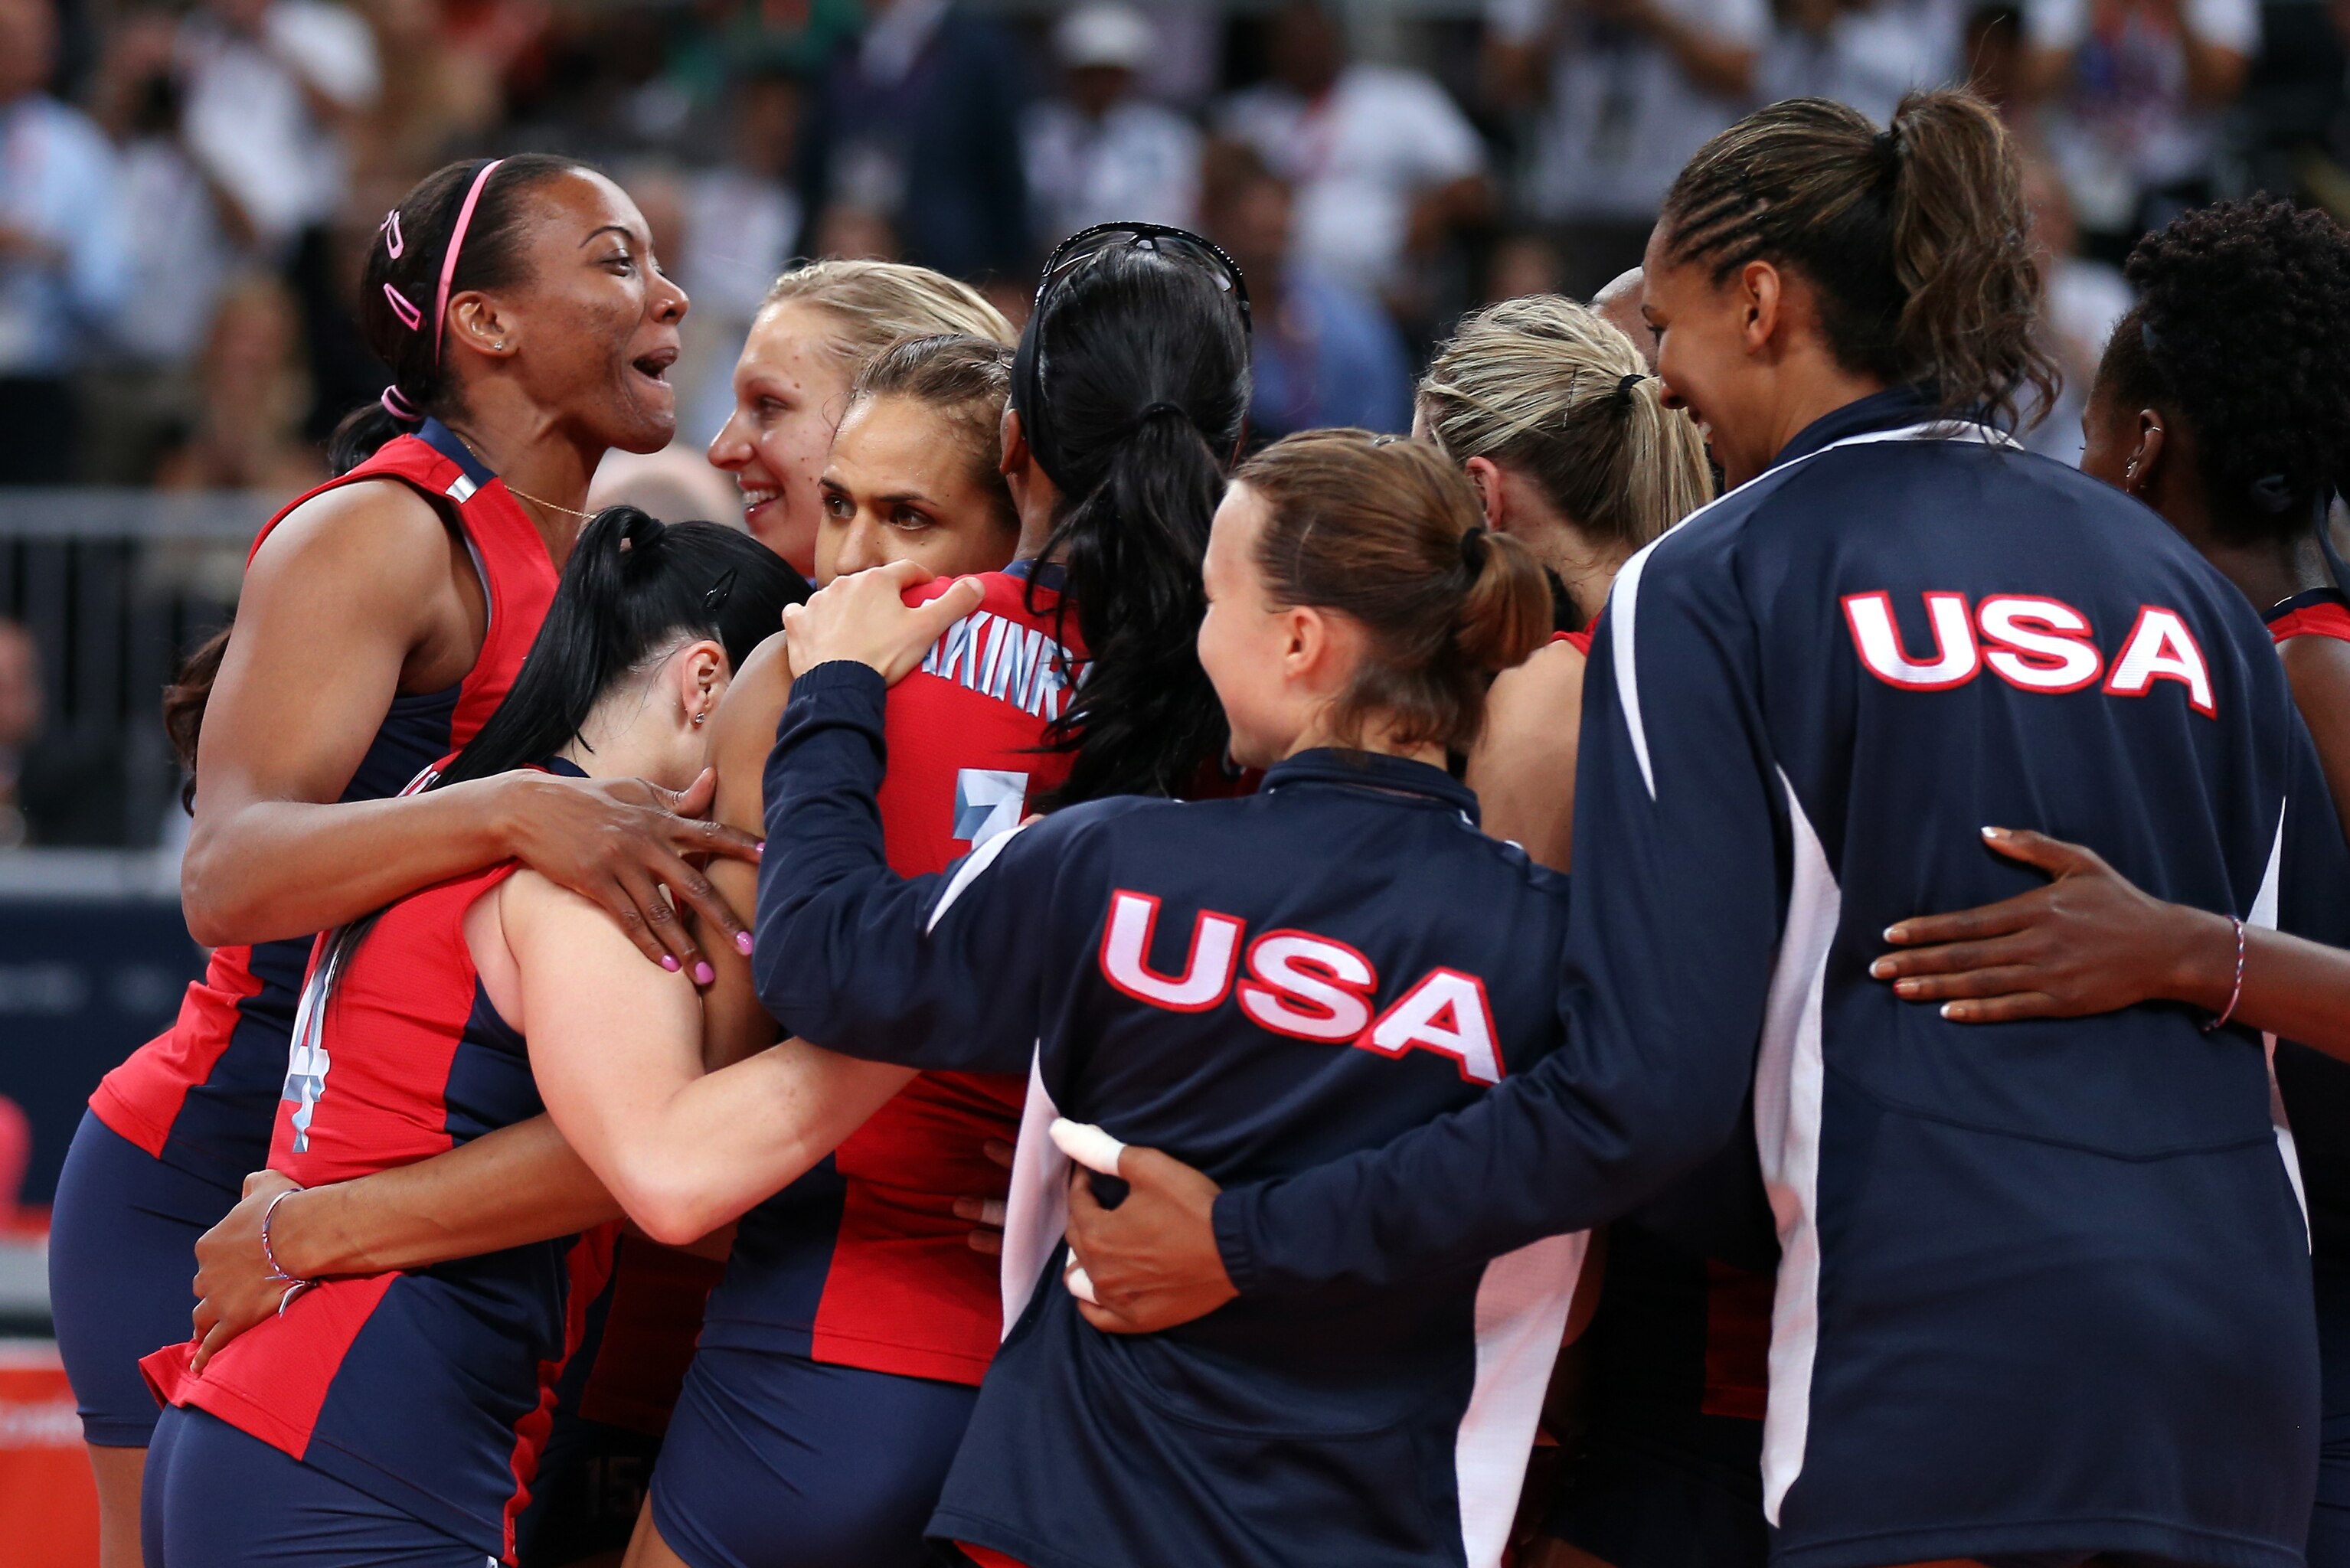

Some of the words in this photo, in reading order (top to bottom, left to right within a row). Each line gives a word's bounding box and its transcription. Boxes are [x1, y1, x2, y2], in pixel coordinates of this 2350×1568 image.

[920, 599, 1096, 723] KINR
[1840, 590, 2218, 720] USA
[1099, 888, 1506, 1087] USA
